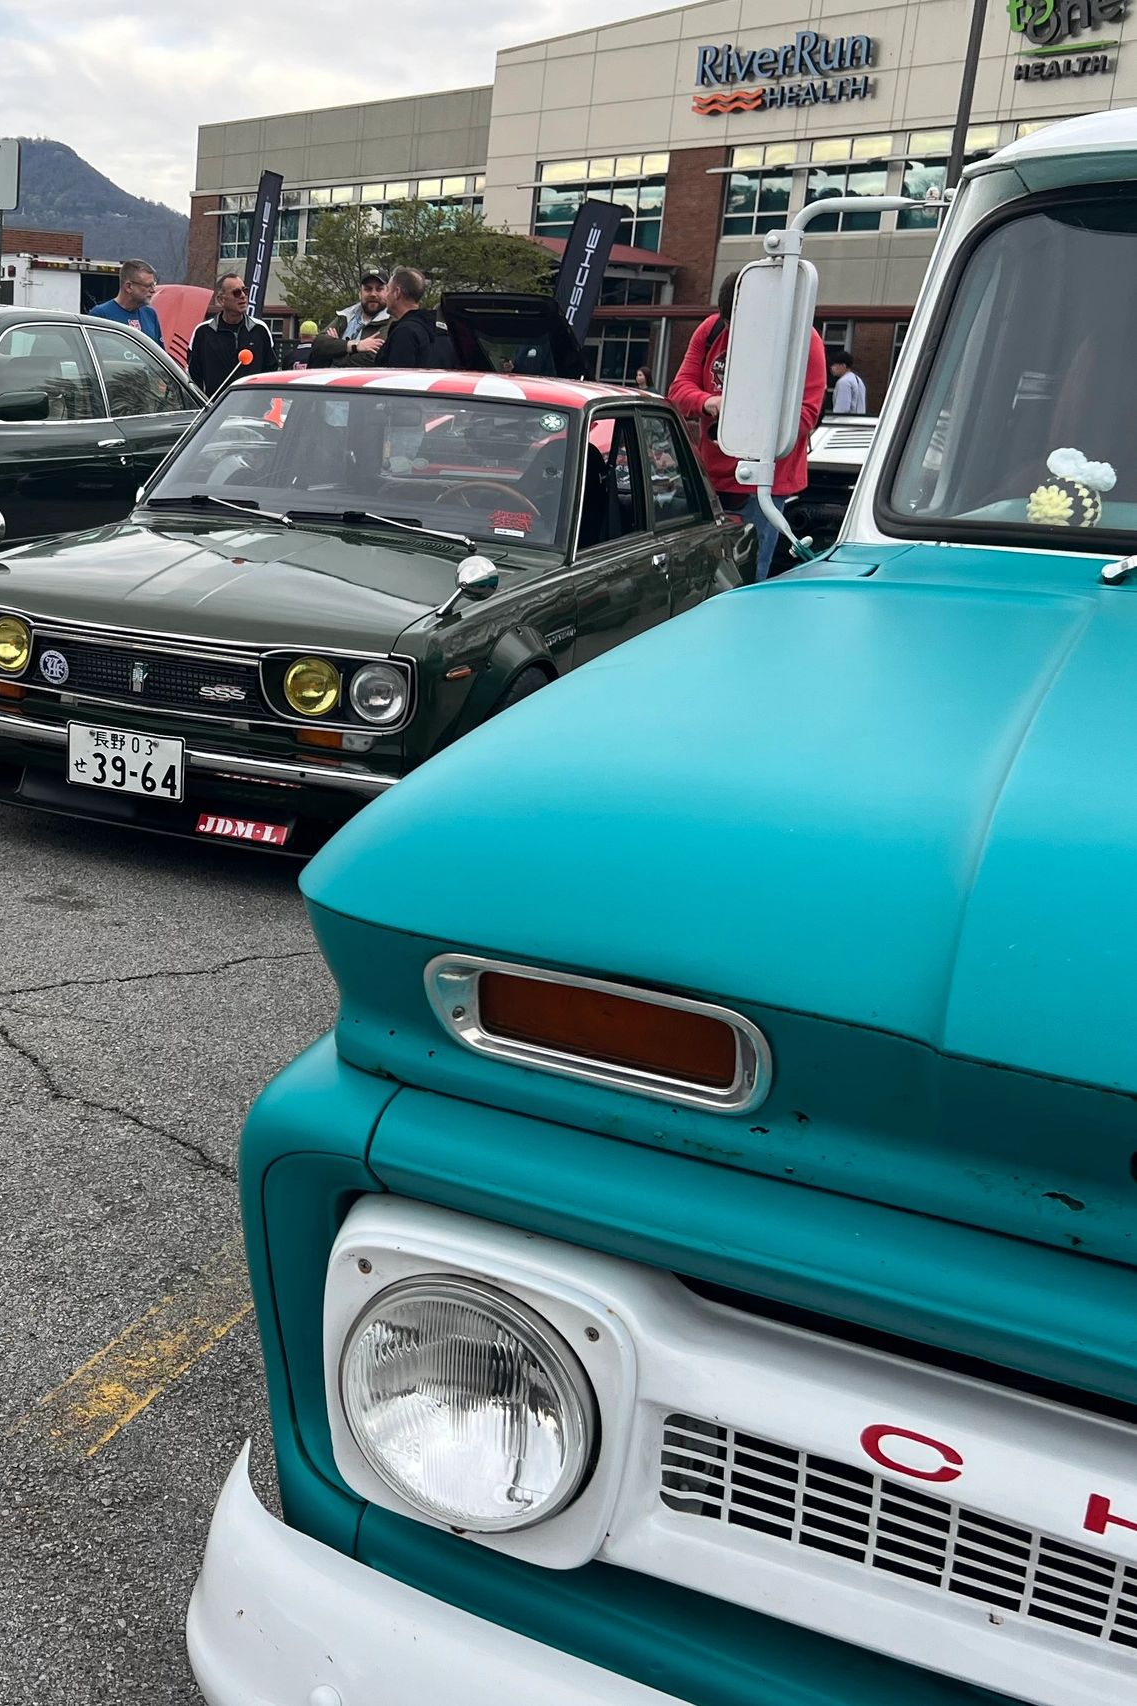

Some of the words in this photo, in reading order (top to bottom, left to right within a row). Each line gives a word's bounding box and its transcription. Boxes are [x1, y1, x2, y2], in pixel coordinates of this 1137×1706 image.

[695, 31, 871, 87] RiverRun
[1014, 55, 1108, 81] HEALTH
[766, 76, 869, 109] HEALTH
[246, 201, 272, 317] ORSCHE
[565, 227, 602, 326] RSCHE
[198, 686, 247, 700] SSS
[94, 731, 125, 751] 長野
[131, 736, 153, 756] 03
[74, 757, 88, 773] せ
[92, 752, 177, 797] 39-64
